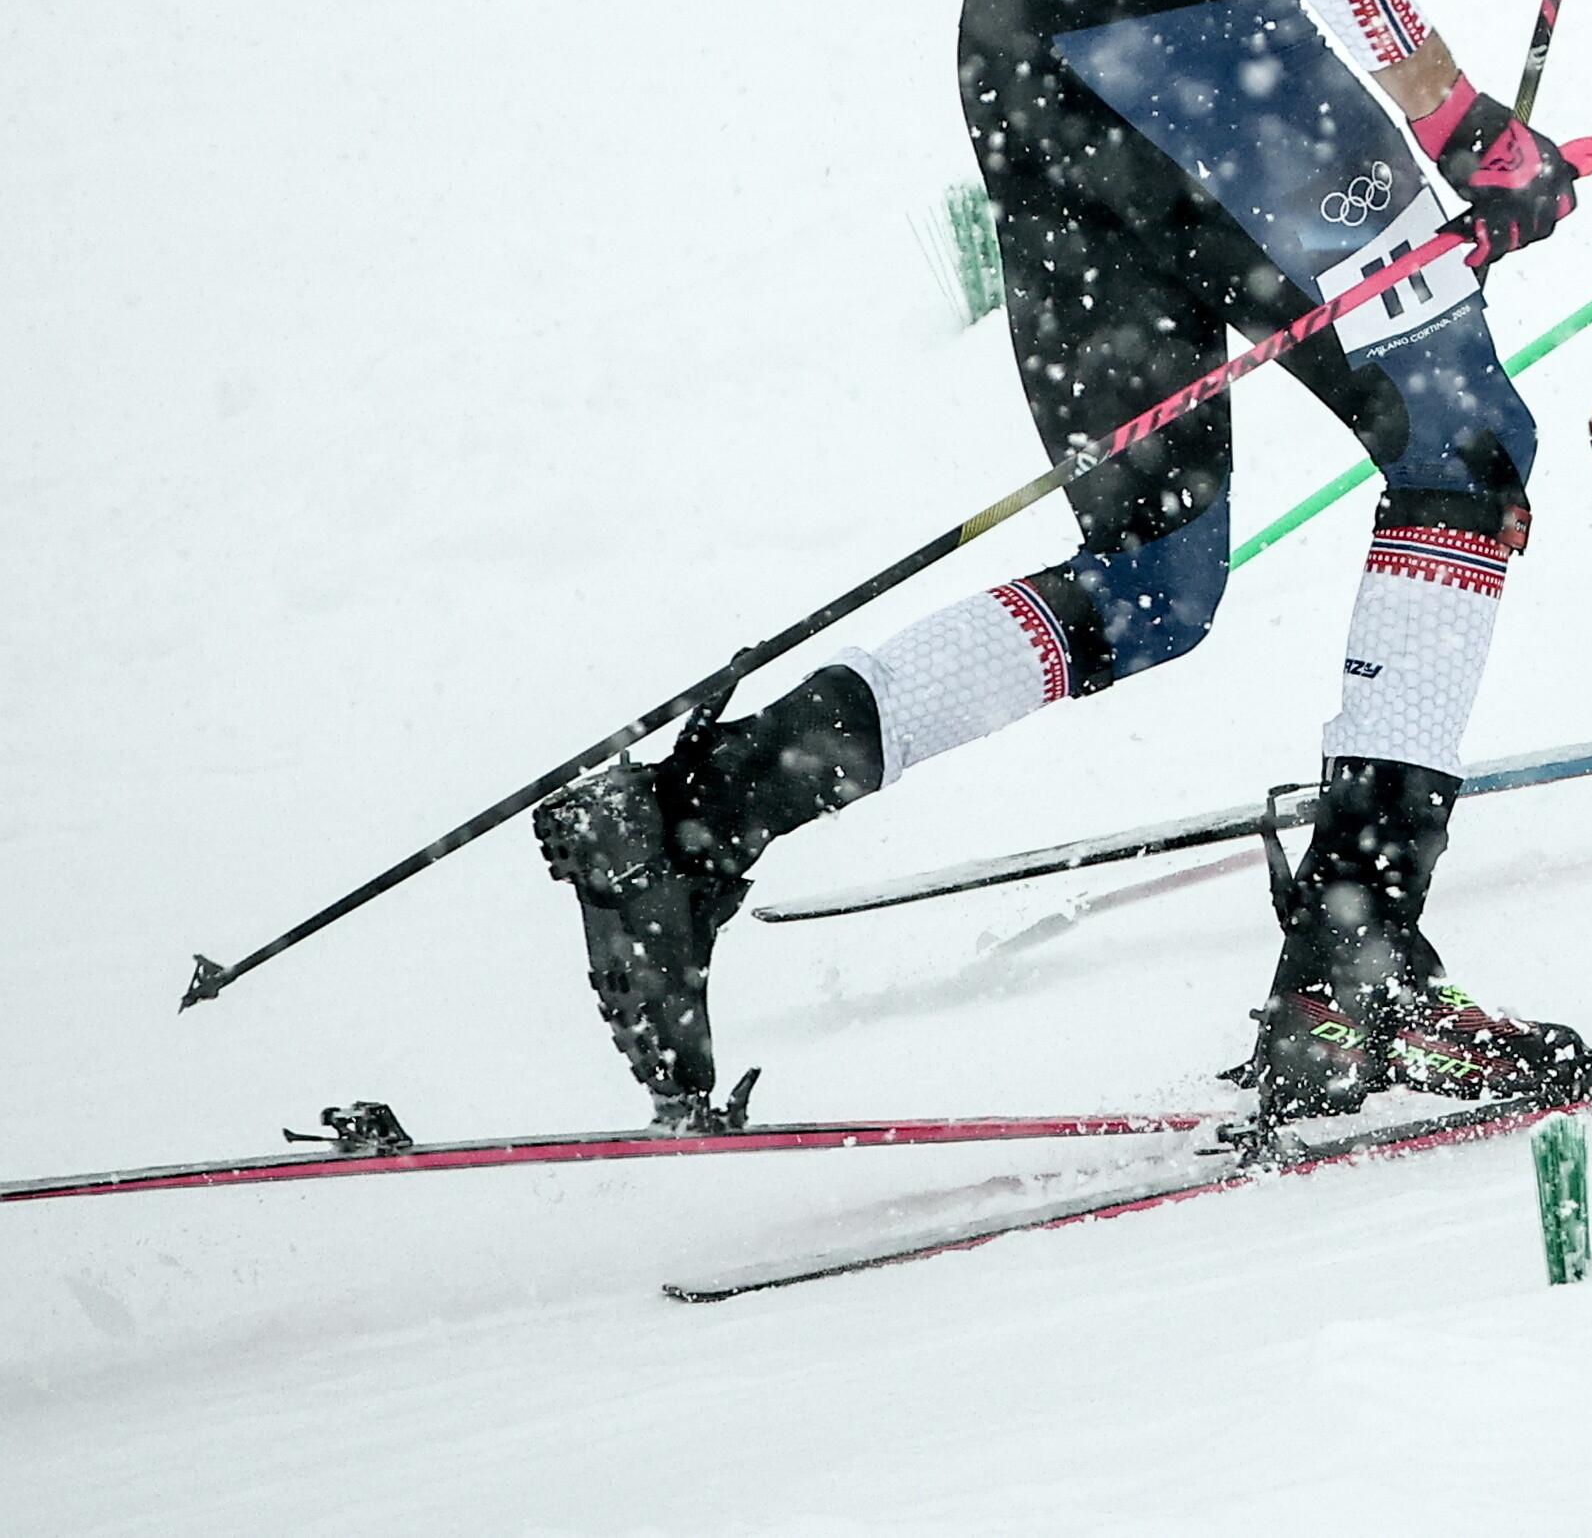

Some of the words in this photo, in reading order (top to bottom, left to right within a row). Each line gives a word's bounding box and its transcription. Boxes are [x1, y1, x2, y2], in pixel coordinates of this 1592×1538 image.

[1360, 239, 1433, 319] 11
[1366, 335, 1409, 358] MILANO
[1409, 317, 1452, 344] CORTINA
